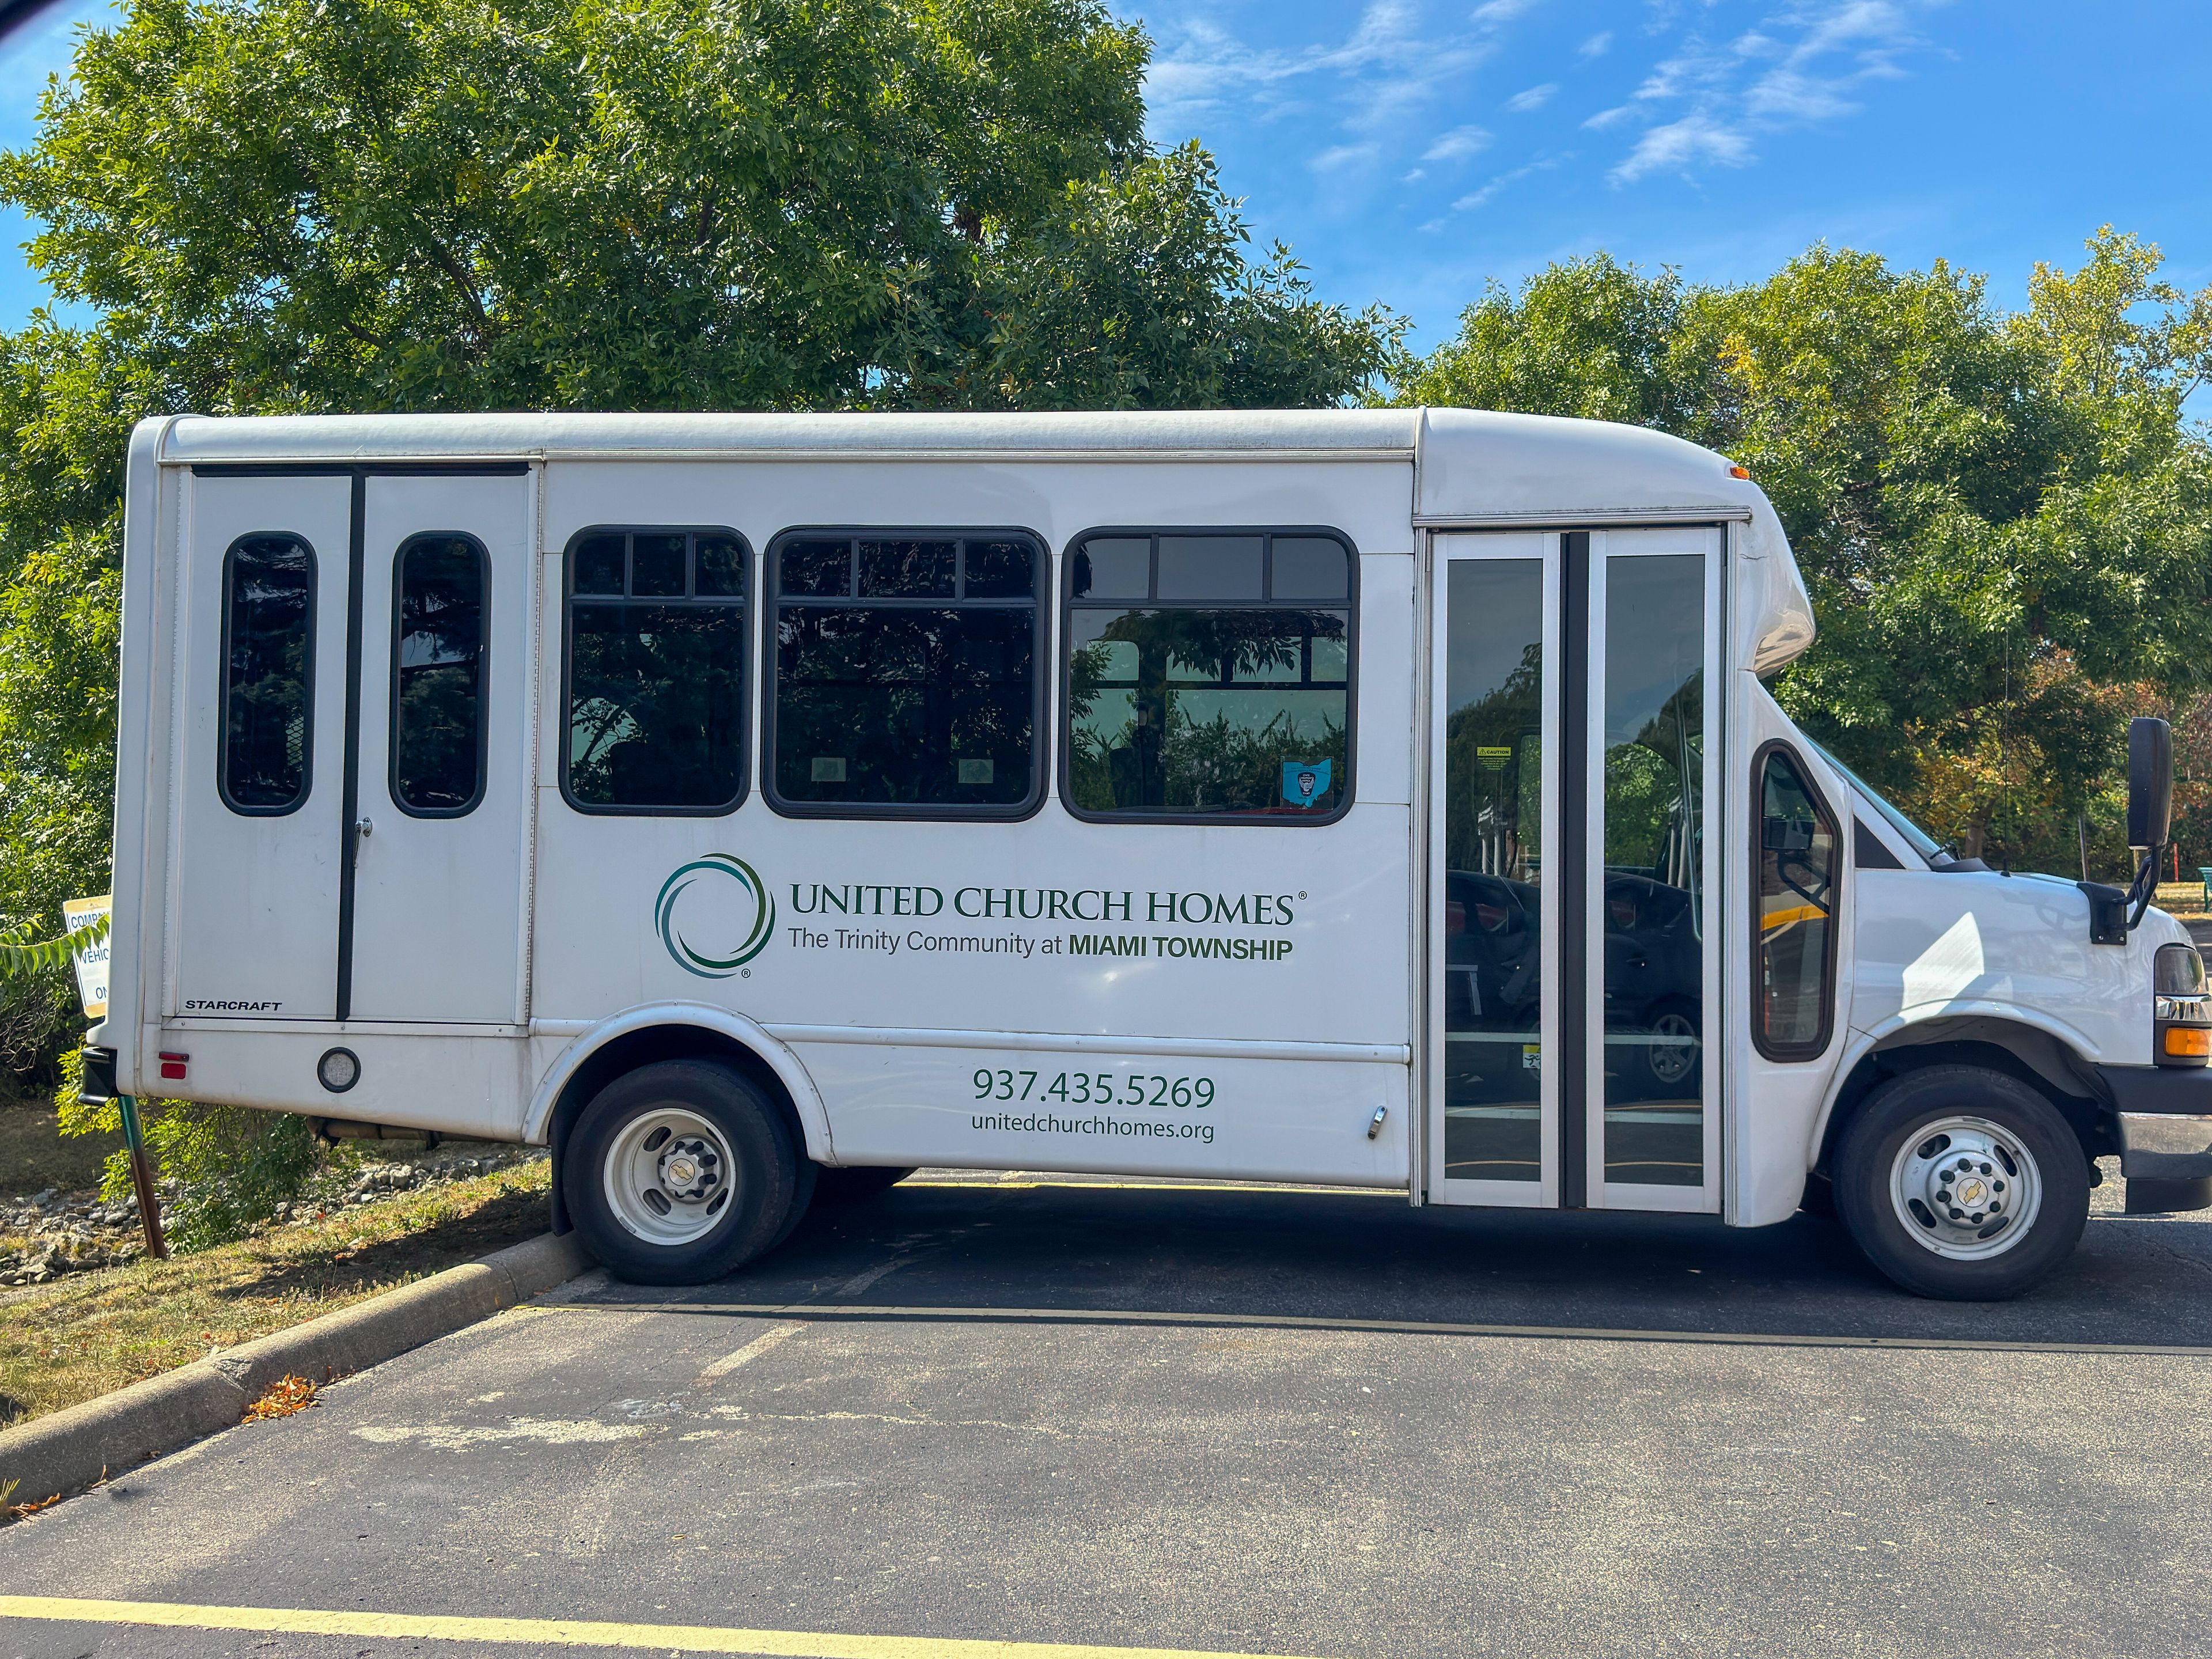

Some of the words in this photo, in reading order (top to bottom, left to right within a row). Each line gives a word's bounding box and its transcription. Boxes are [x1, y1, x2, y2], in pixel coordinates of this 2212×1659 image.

[789, 884, 944, 916] UNITED
[954, 887, 1134, 921] CHURCH
[787, 927, 829, 948] The
[834, 928, 901, 956] Trinity
[907, 930, 1036, 959] Community
[1041, 935, 1062, 955] at
[1069, 934, 1147, 957] MIAMI
[1152, 936, 1293, 961] TOWNSHIP
[185, 1000, 282, 1011] STARCRAFT
[973, 1069, 1215, 1108] 937.435.5269
[972, 1112, 1214, 1144] unitedchurchhomes.org
